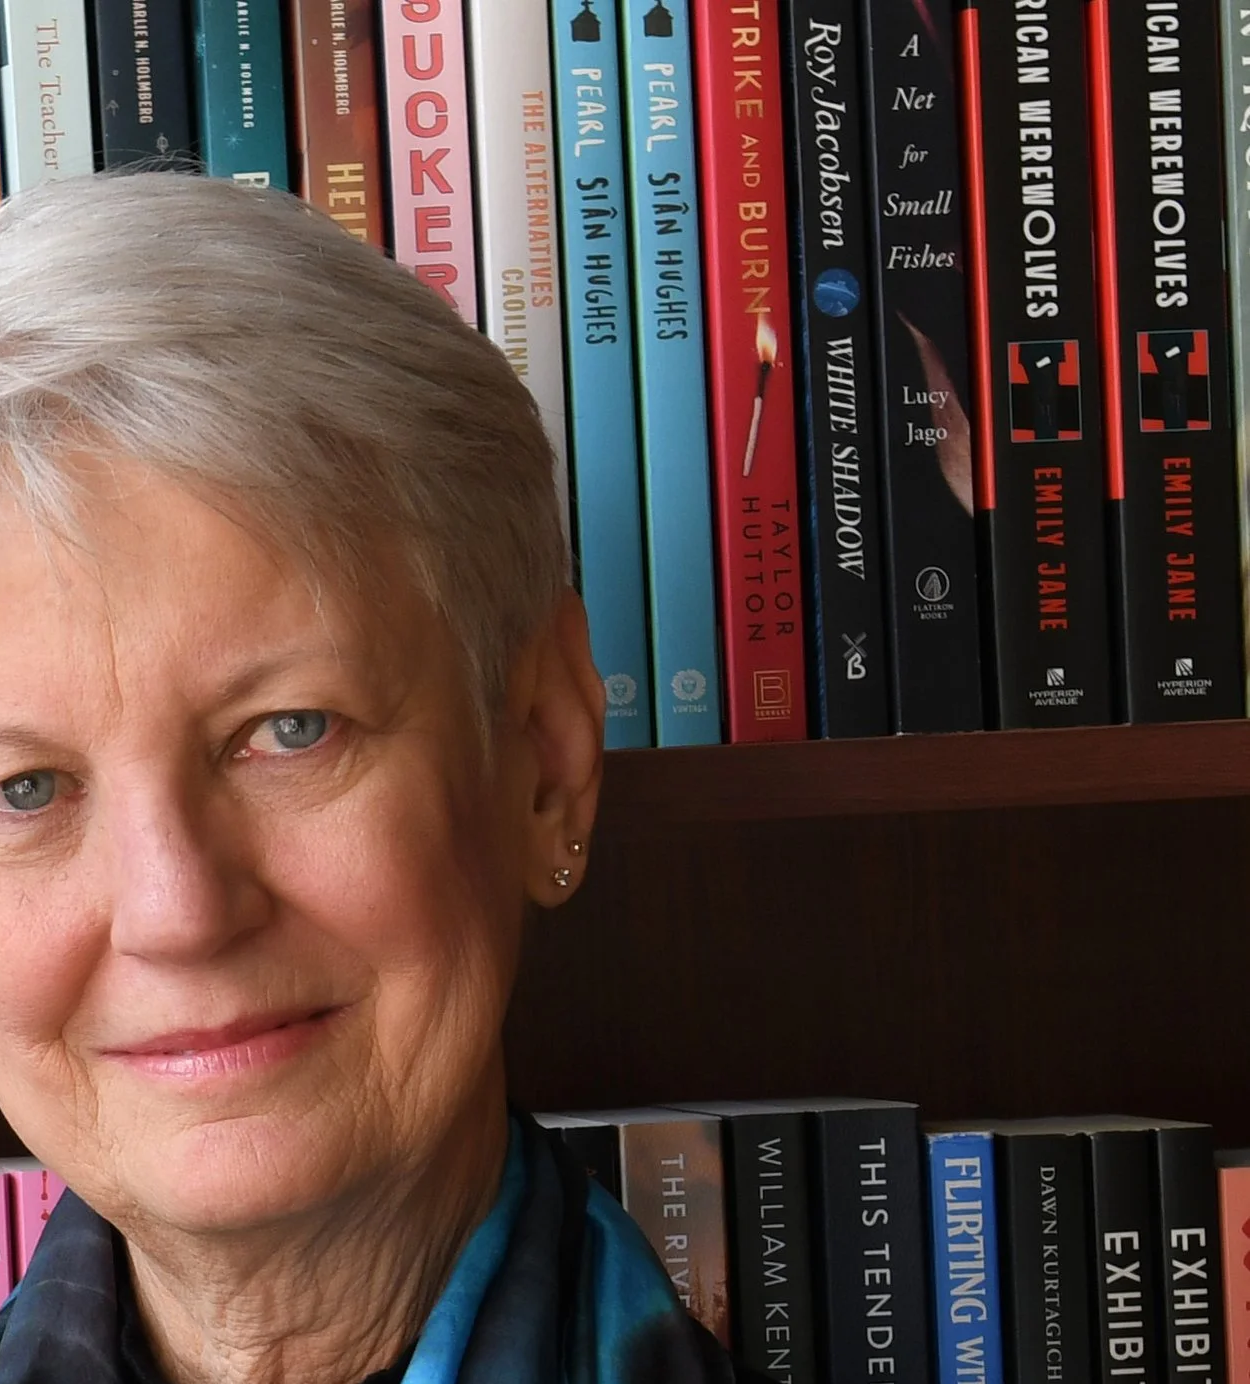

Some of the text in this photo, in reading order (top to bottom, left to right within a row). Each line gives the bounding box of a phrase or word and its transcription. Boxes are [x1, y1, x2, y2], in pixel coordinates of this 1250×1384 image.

[900, 34, 920, 57] A
[36, 19, 65, 172] The Teacher
[571, 66, 603, 158] PEARL
[891, 87, 936, 111] Net
[740, 134, 761, 188] AND
[804, 18, 851, 250] Roy Jacobsen
[898, 144, 929, 169] for
[522, 91, 553, 308] THE ALTERNATIVES
[884, 191, 952, 217] Small
[1018, 100, 1059, 319] WEREWOLVES
[738, 201, 771, 314] BURN
[886, 244, 955, 270] Fishes
[583, 254, 617, 344] HUGHES
[902, 386, 950, 408] Lucy
[825, 336, 866, 579] WHITE SHADOW
[904, 422, 948, 447] Jago
[1034, 466, 1067, 632] EMILY JANE
[914, 603, 953, 611] FLATIRON
[1029, 689, 1083, 699] HYPERION
[1035, 698, 1078, 706] AVENUE
[944, 1155, 988, 1325] FLIRTING
[1039, 1165, 1063, 1382] DAWN KURTAGICH
